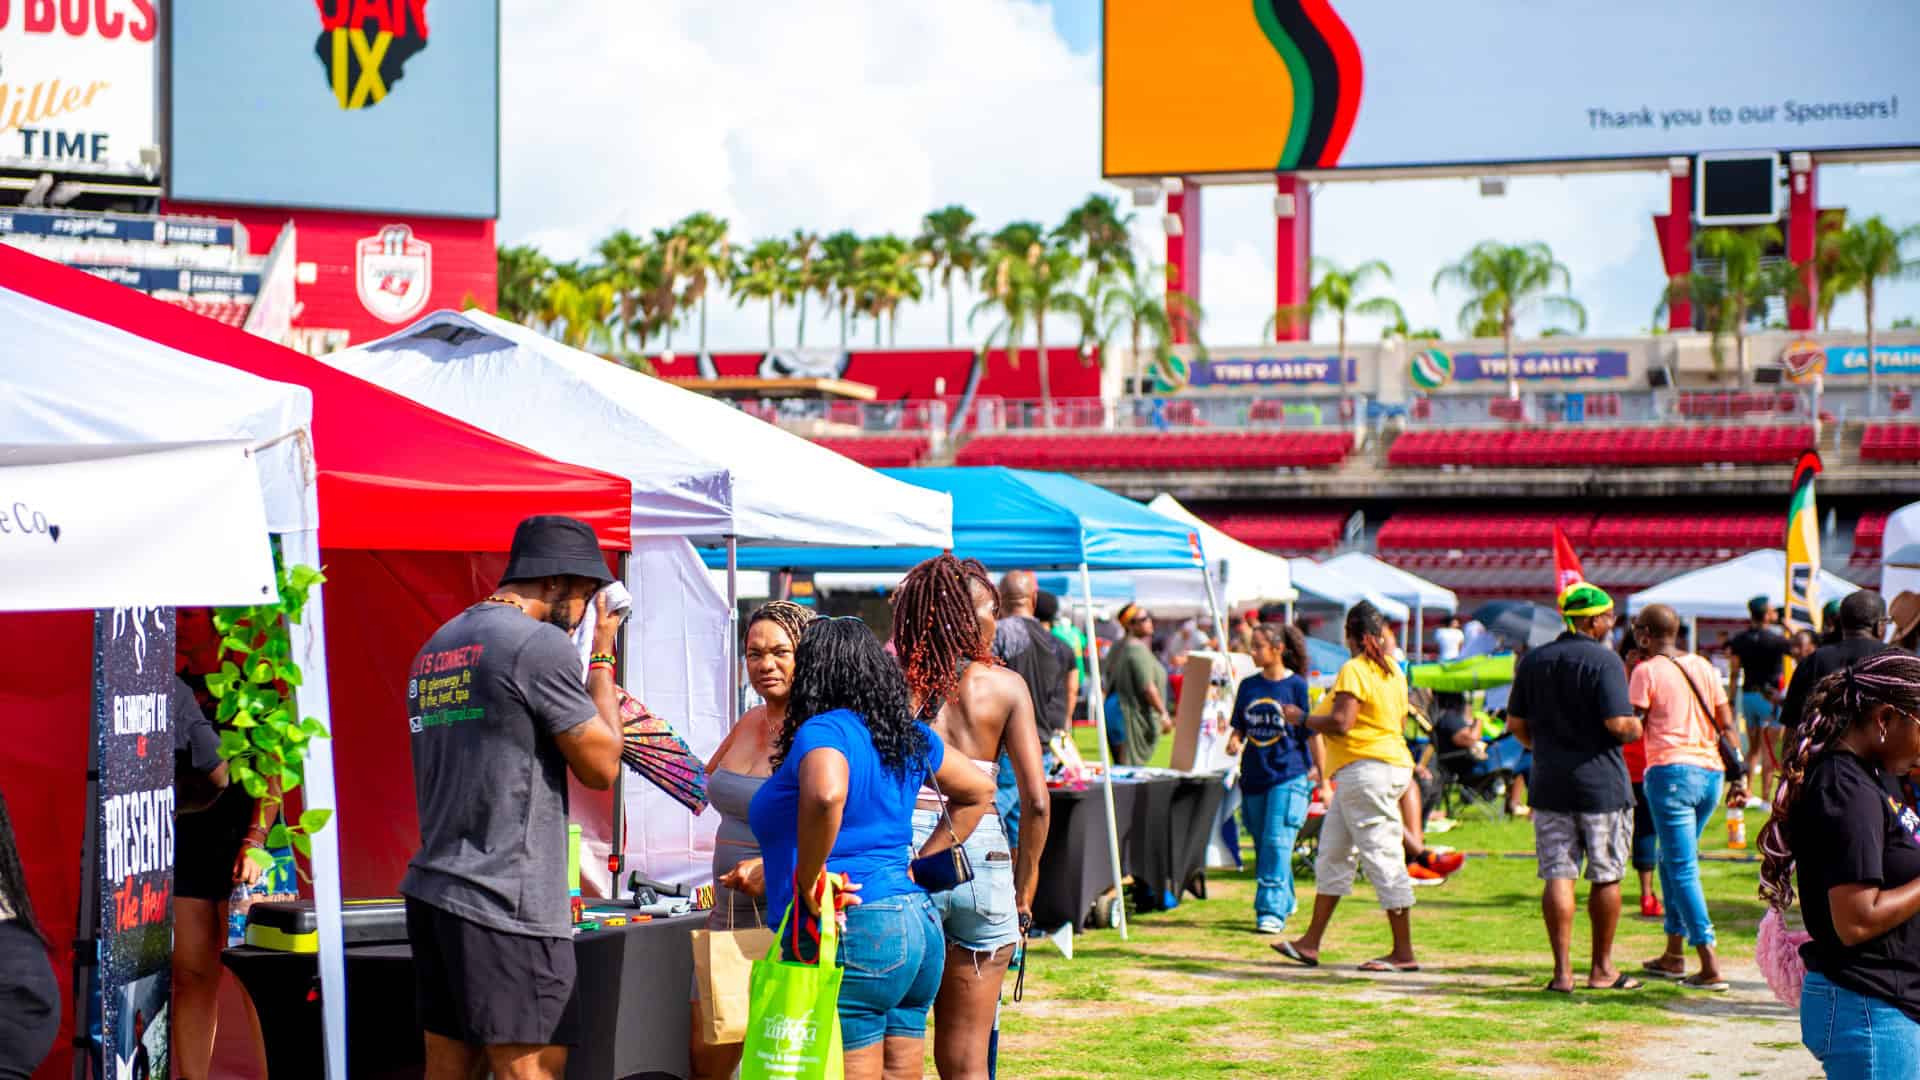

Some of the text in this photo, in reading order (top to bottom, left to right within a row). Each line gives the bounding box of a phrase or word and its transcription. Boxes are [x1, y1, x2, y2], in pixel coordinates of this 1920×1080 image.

[332, 27, 393, 109] IX
[1587, 95, 1898, 130] Thank you to our Sponsors!
[1213, 363, 1328, 379] THE GALLEY
[1523, 357, 1598, 373] GALLEY
[105, 785, 175, 883] PRESENTS
